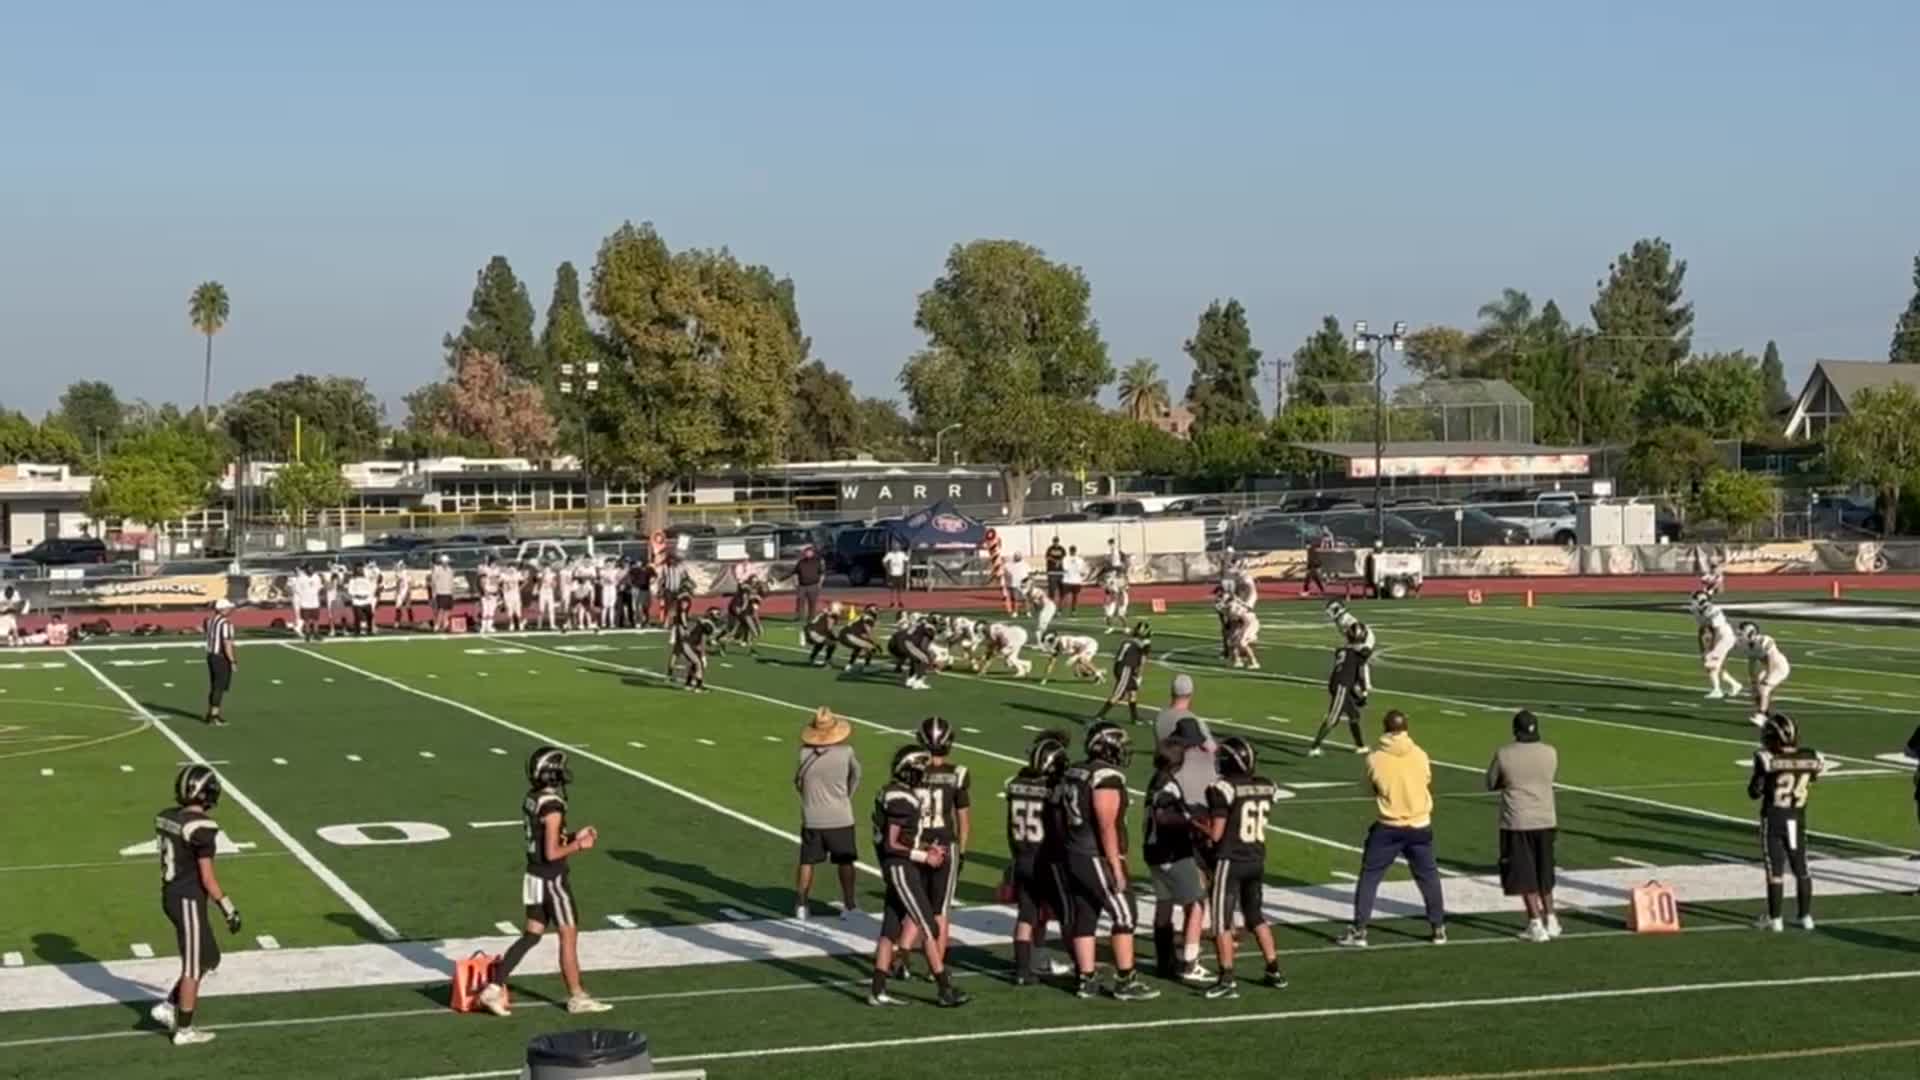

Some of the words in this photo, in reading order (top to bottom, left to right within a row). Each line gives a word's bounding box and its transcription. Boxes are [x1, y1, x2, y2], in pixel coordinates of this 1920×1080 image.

[841, 481, 1099, 499] WARRIRS
[1773, 773, 1808, 808] 24
[1011, 799, 1044, 842] 55
